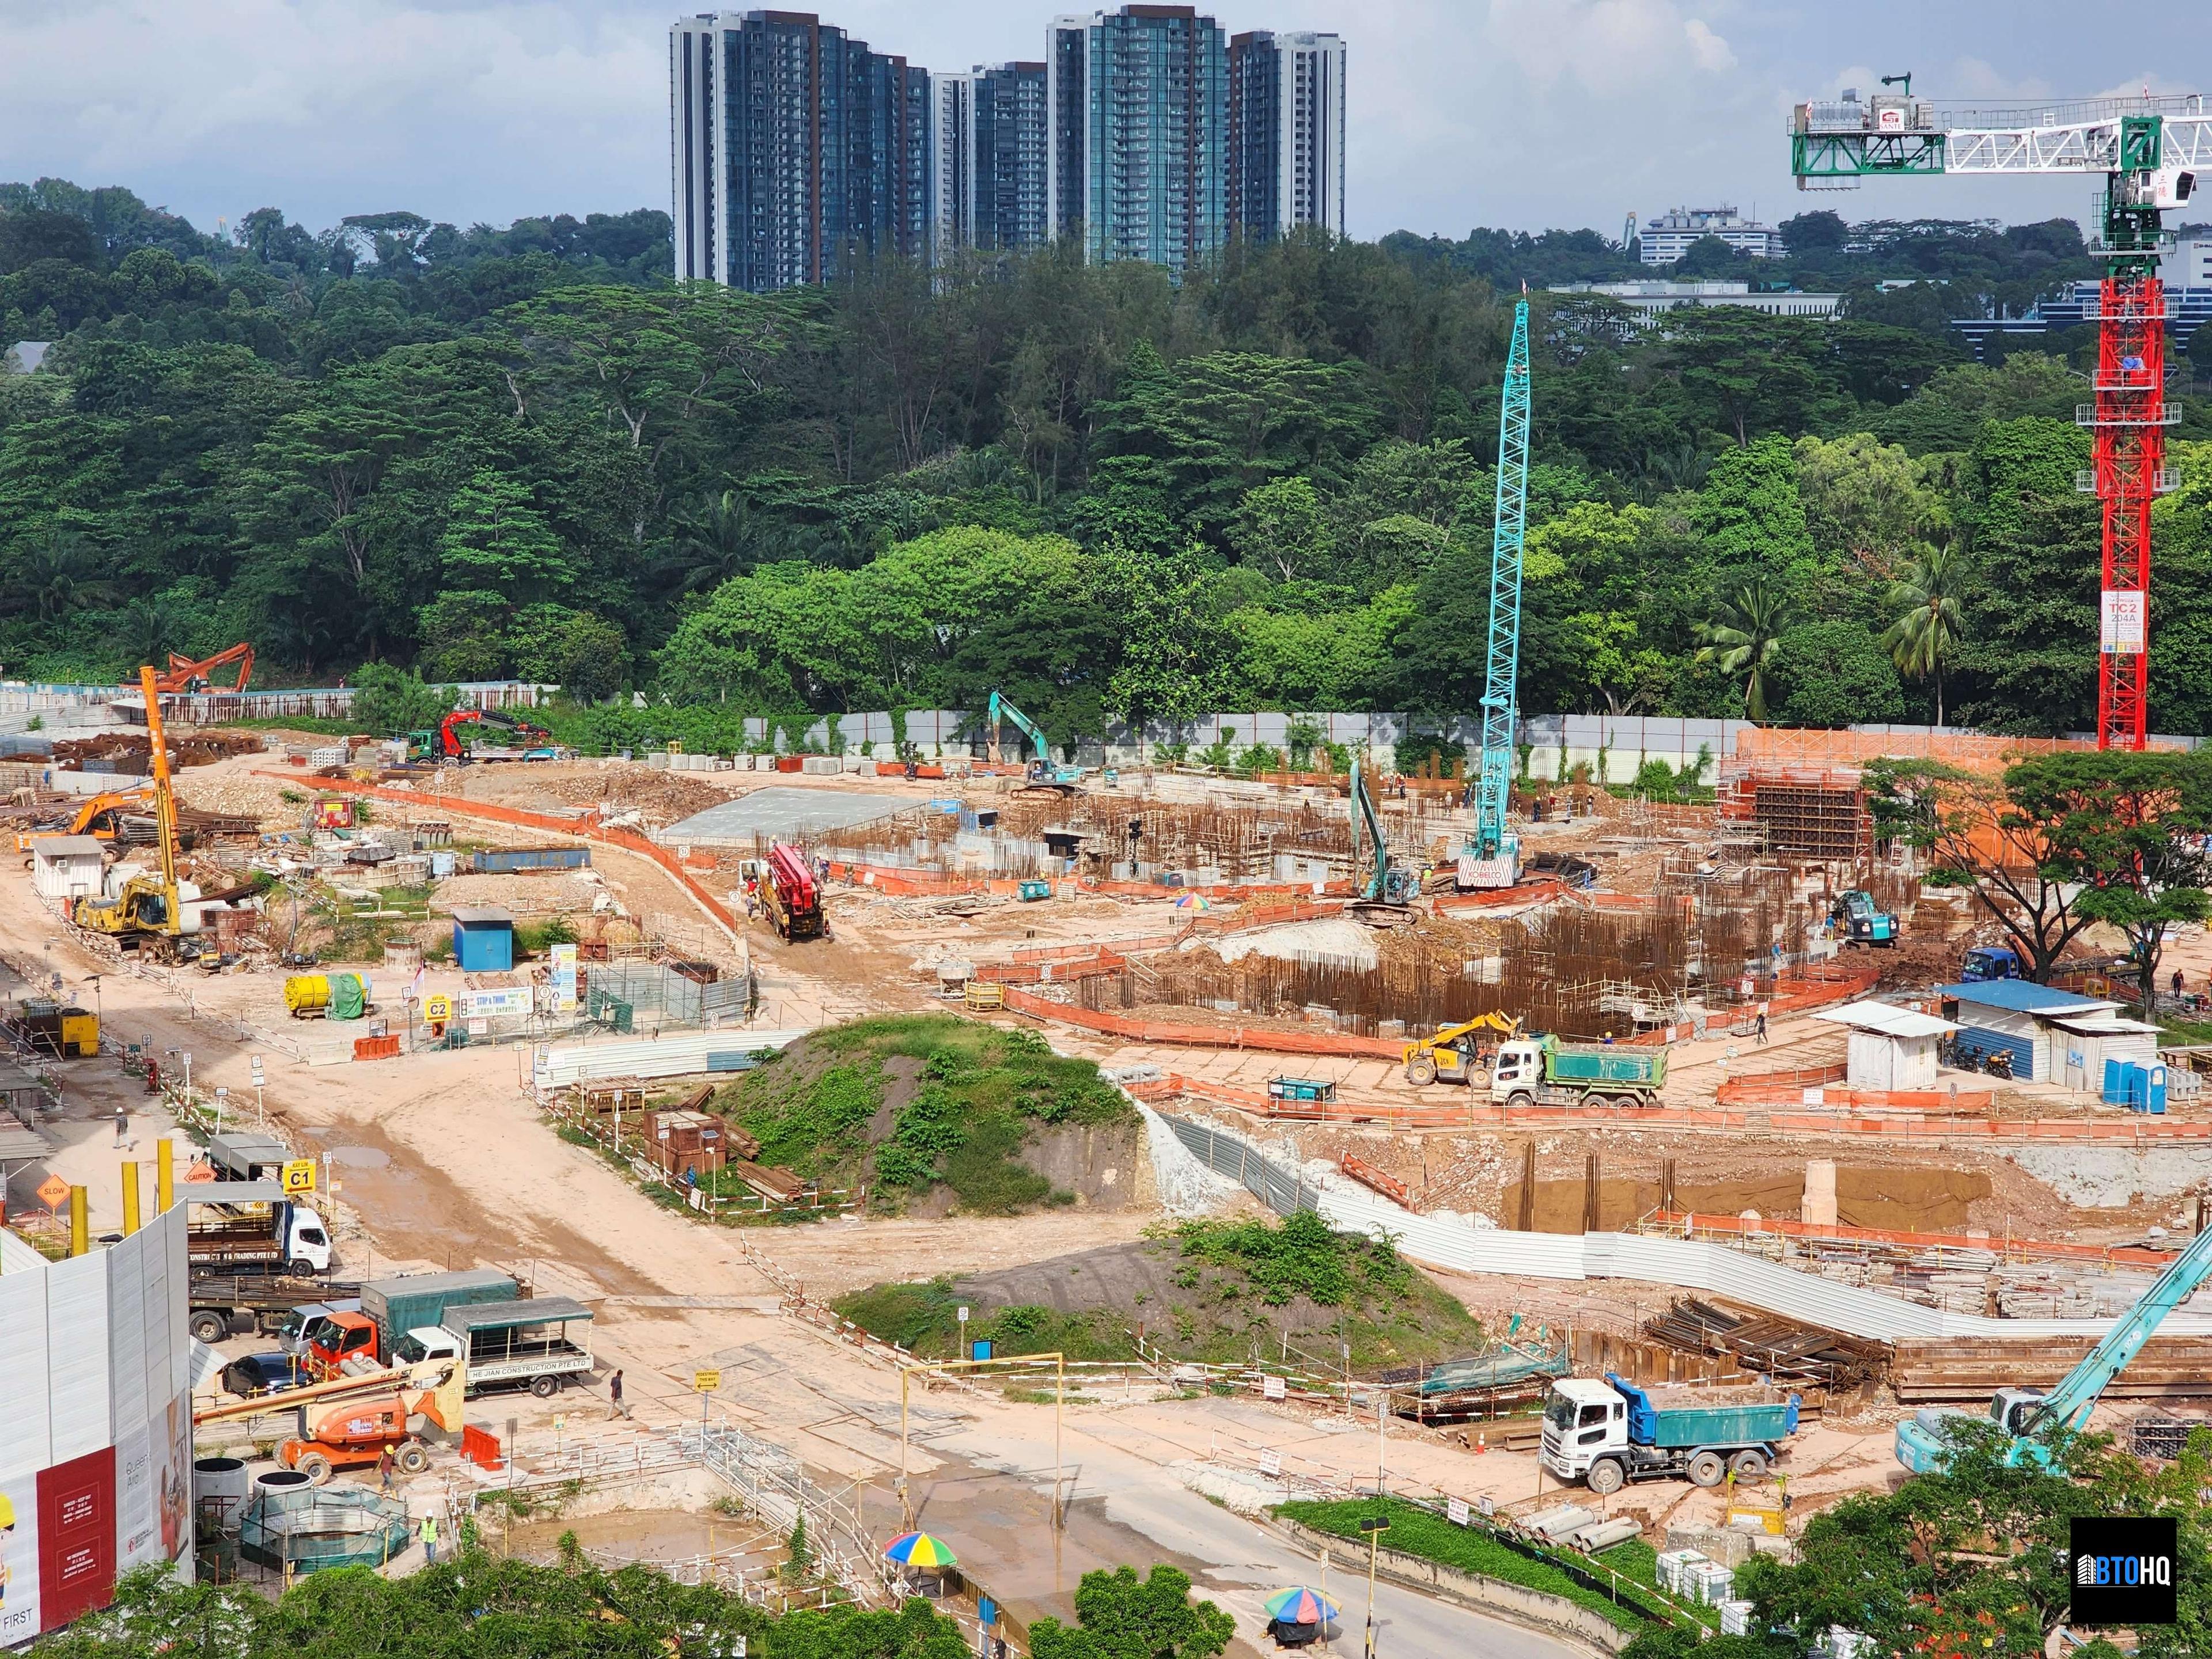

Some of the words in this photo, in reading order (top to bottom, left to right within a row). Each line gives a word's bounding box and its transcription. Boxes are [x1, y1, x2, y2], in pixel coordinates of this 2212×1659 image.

[2109, 603, 2137, 613] TC2
[2111, 614, 2136, 622] 204A
[1468, 871, 1502, 879] KOBELCO
[476, 997, 488, 1005] STOP
[430, 1004, 446, 1015] C2
[290, 1172, 309, 1185] C1
[484, 1369, 500, 1377] JIAN
[502, 1363, 556, 1375] CONSTRUCTION
[3, 1608, 32, 1630] FIRST
